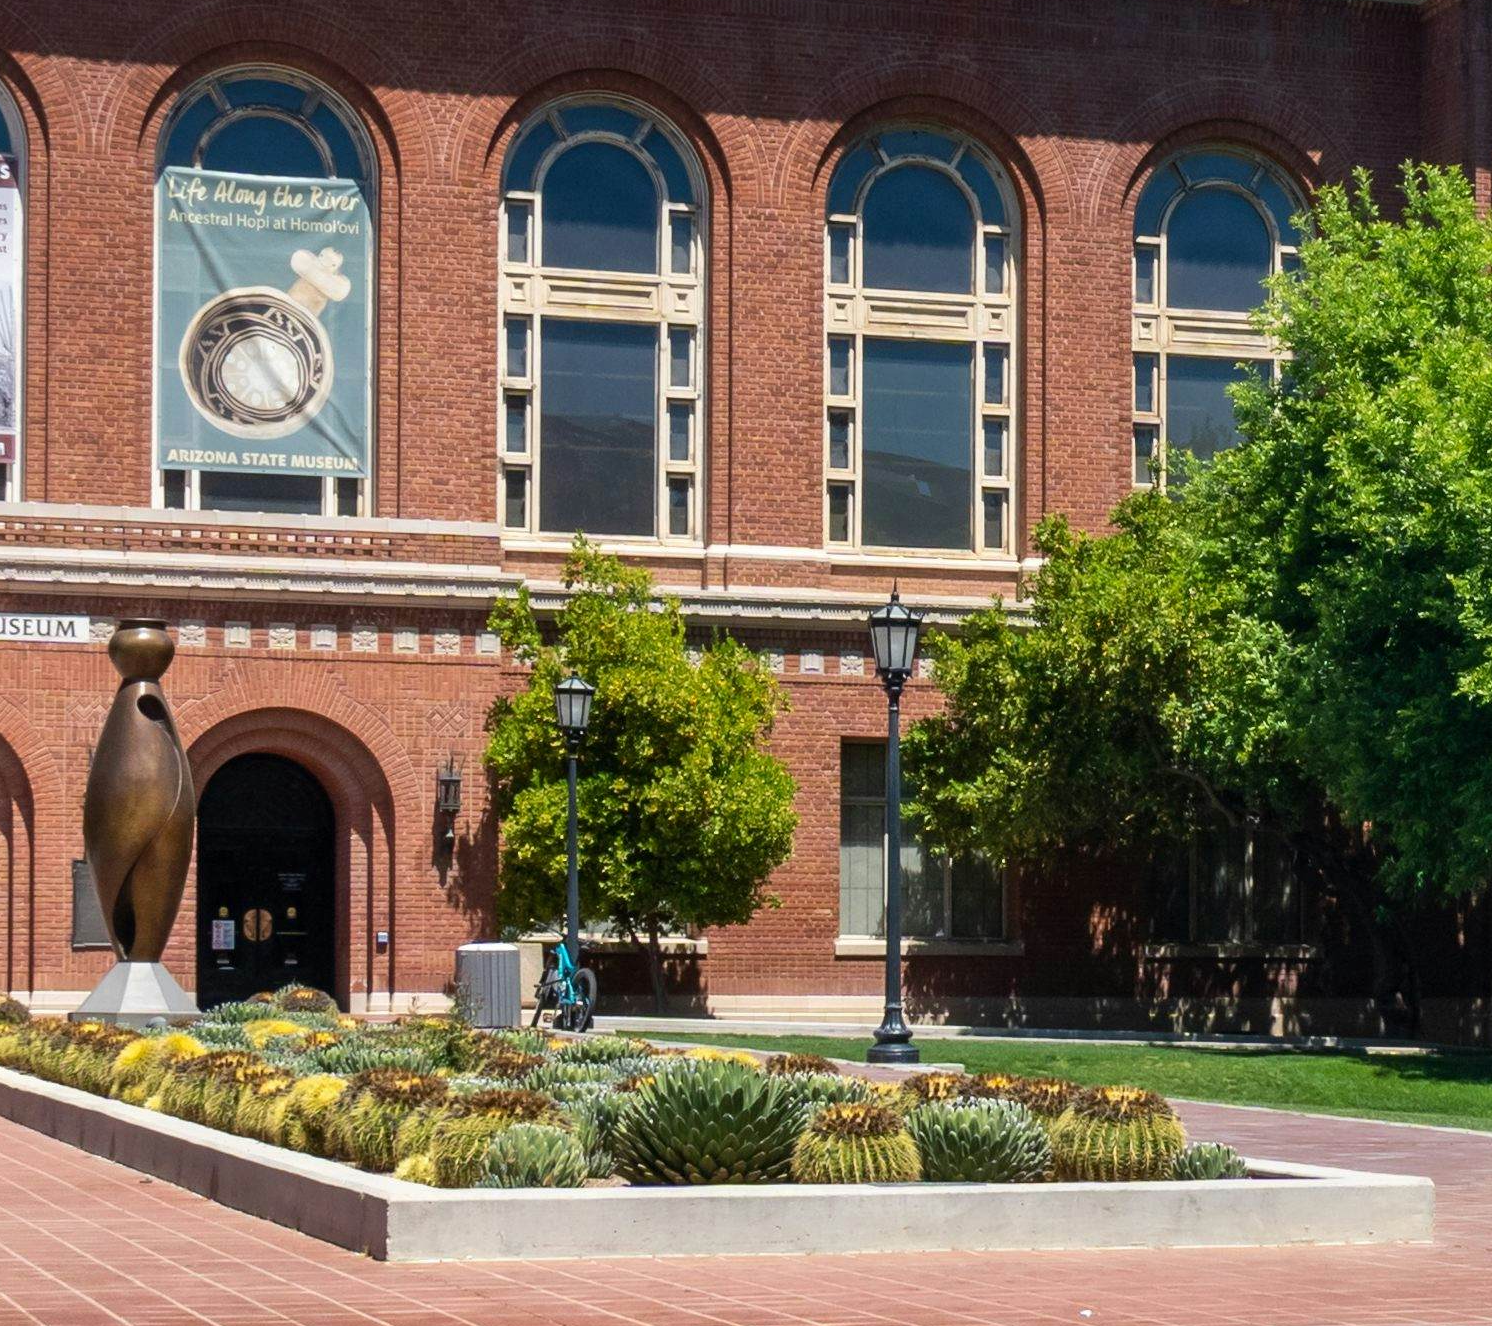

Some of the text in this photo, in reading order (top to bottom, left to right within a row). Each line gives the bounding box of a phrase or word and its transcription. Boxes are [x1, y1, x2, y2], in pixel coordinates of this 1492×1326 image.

[168, 176, 360, 215] Life Along the River
[167, 208, 233, 227] Ancestral
[236, 214, 270, 232] Hopi
[273, 219, 287, 230] at
[167, 449, 358, 471] ARIZONA STATE MUSEUM
